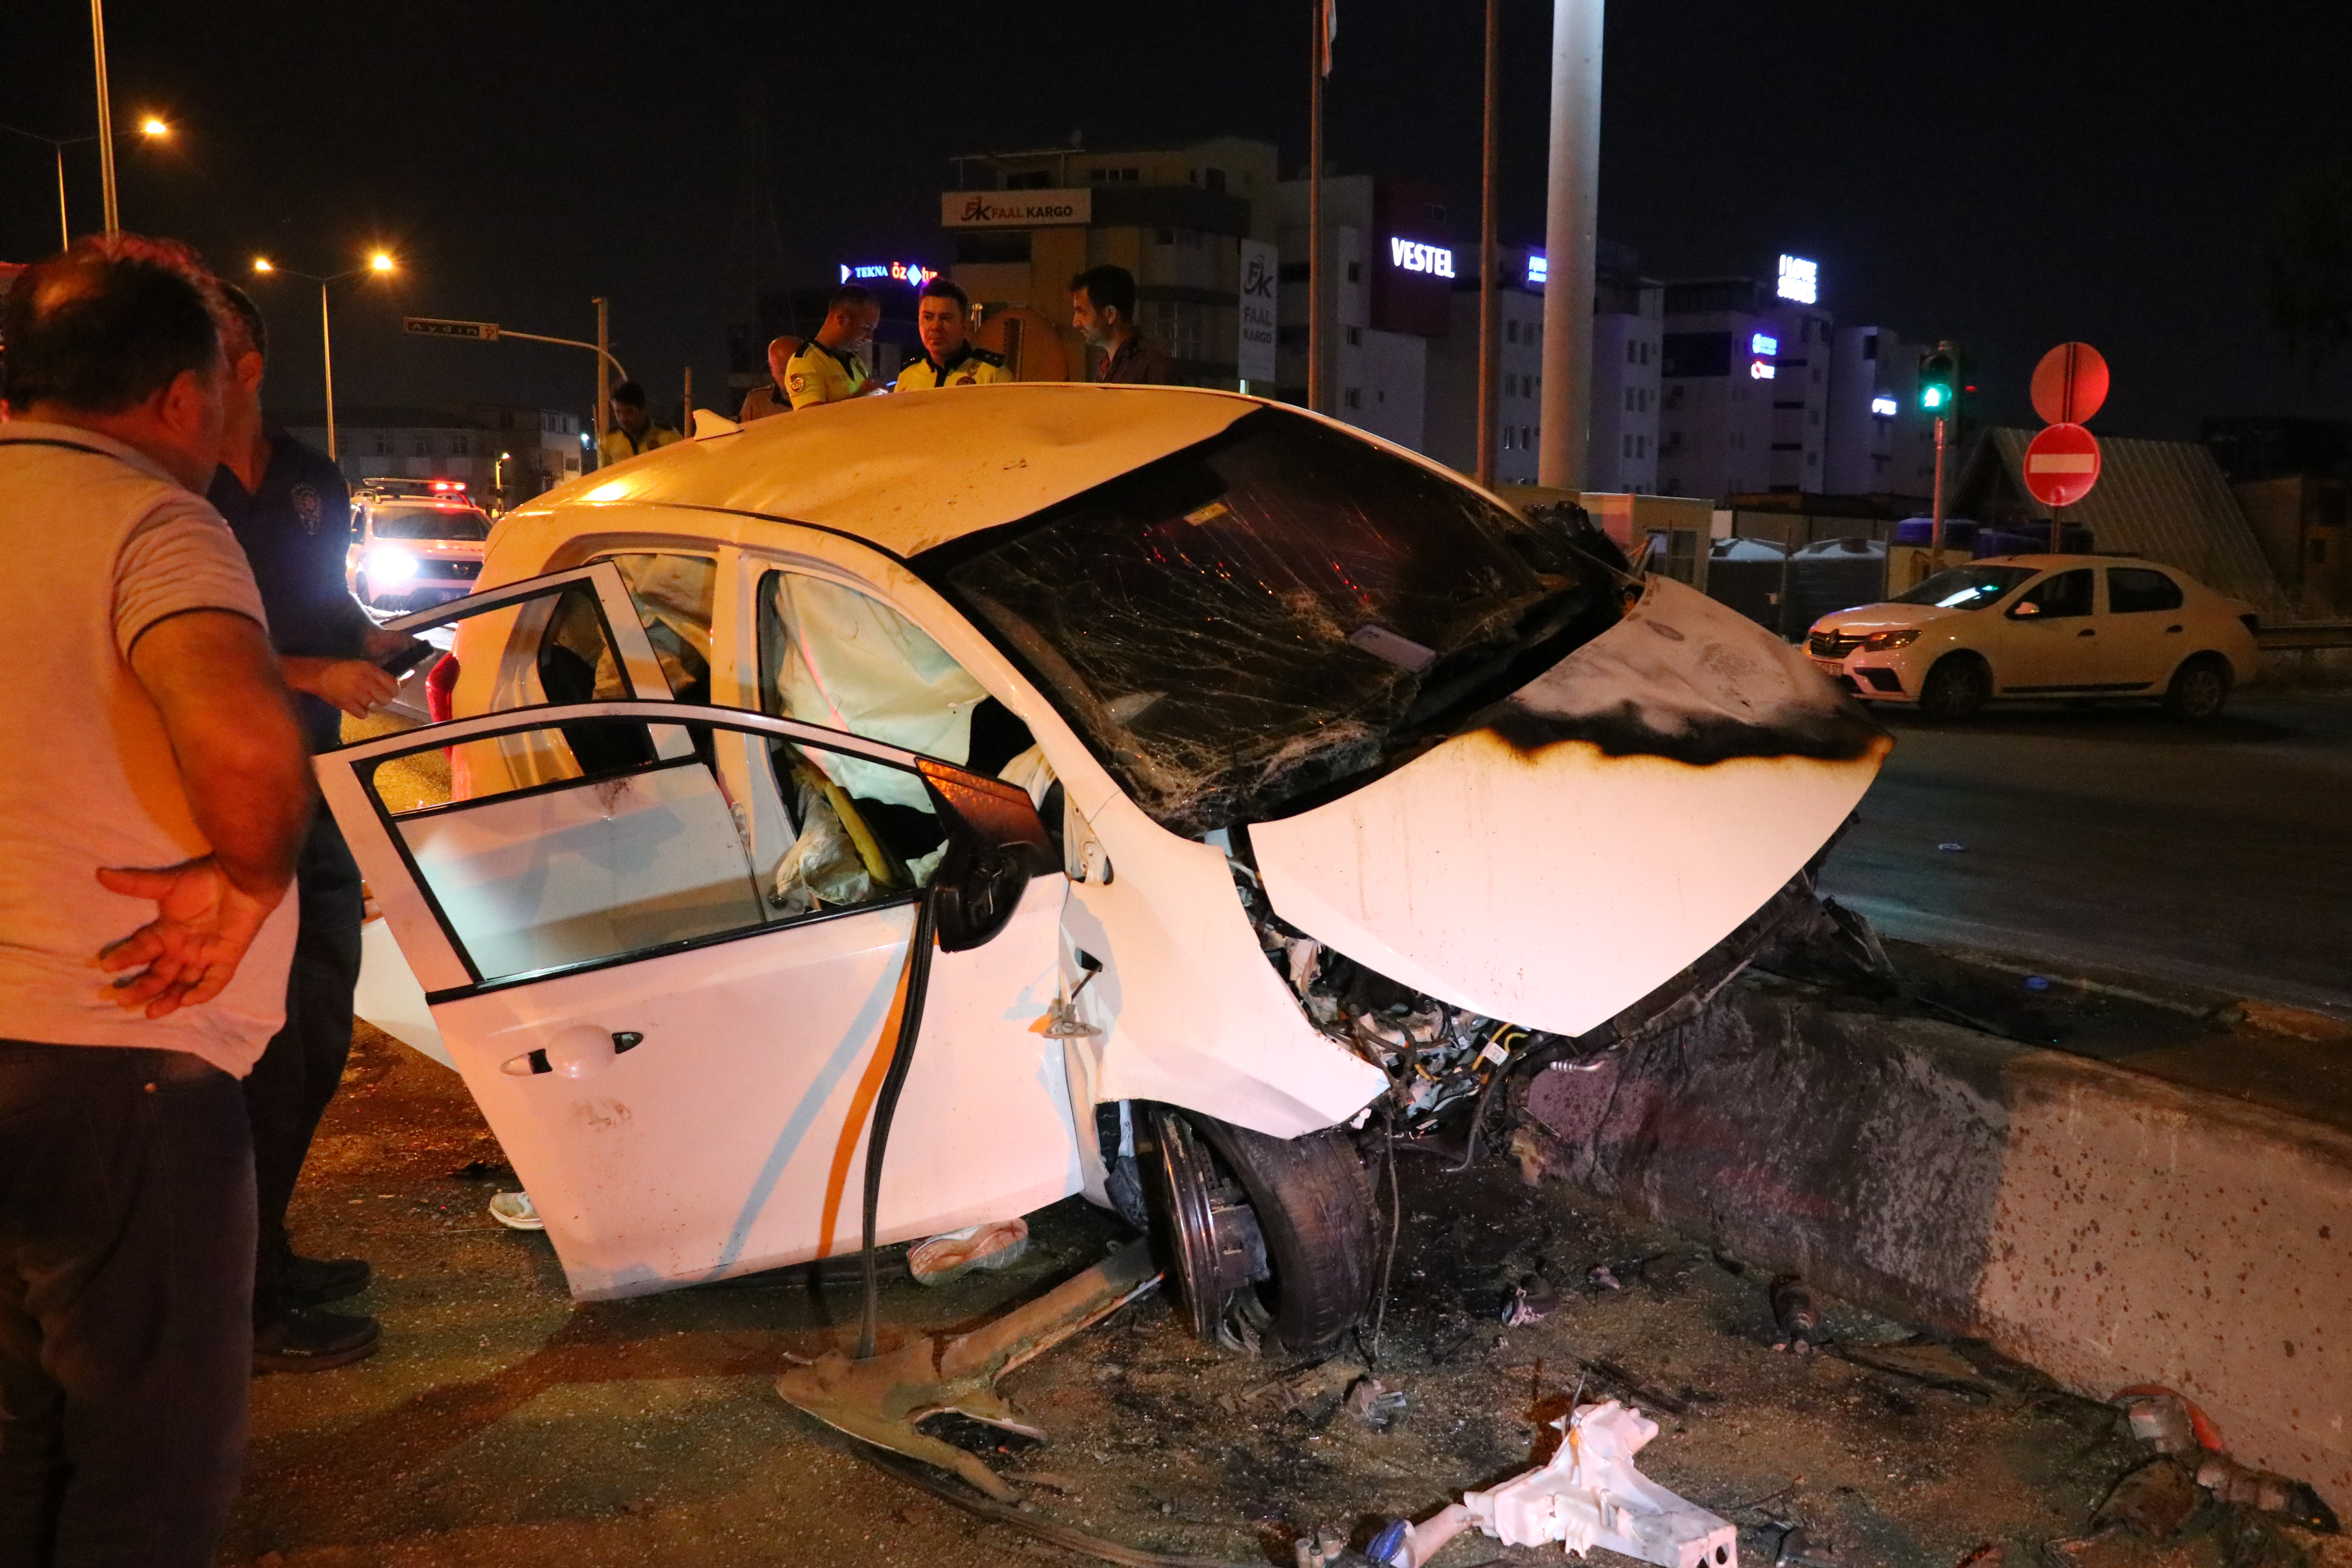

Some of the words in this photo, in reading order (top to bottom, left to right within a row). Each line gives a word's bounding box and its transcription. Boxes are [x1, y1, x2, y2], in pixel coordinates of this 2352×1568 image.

[991, 207, 1024, 218] FAAL
[1026, 206, 1073, 218] KARGO
[1391, 237, 1455, 278] VESTEL
[855, 265, 889, 278] TEKNA
[1244, 306, 1273, 327] FAAL
[1244, 328, 1271, 344] KARGO
